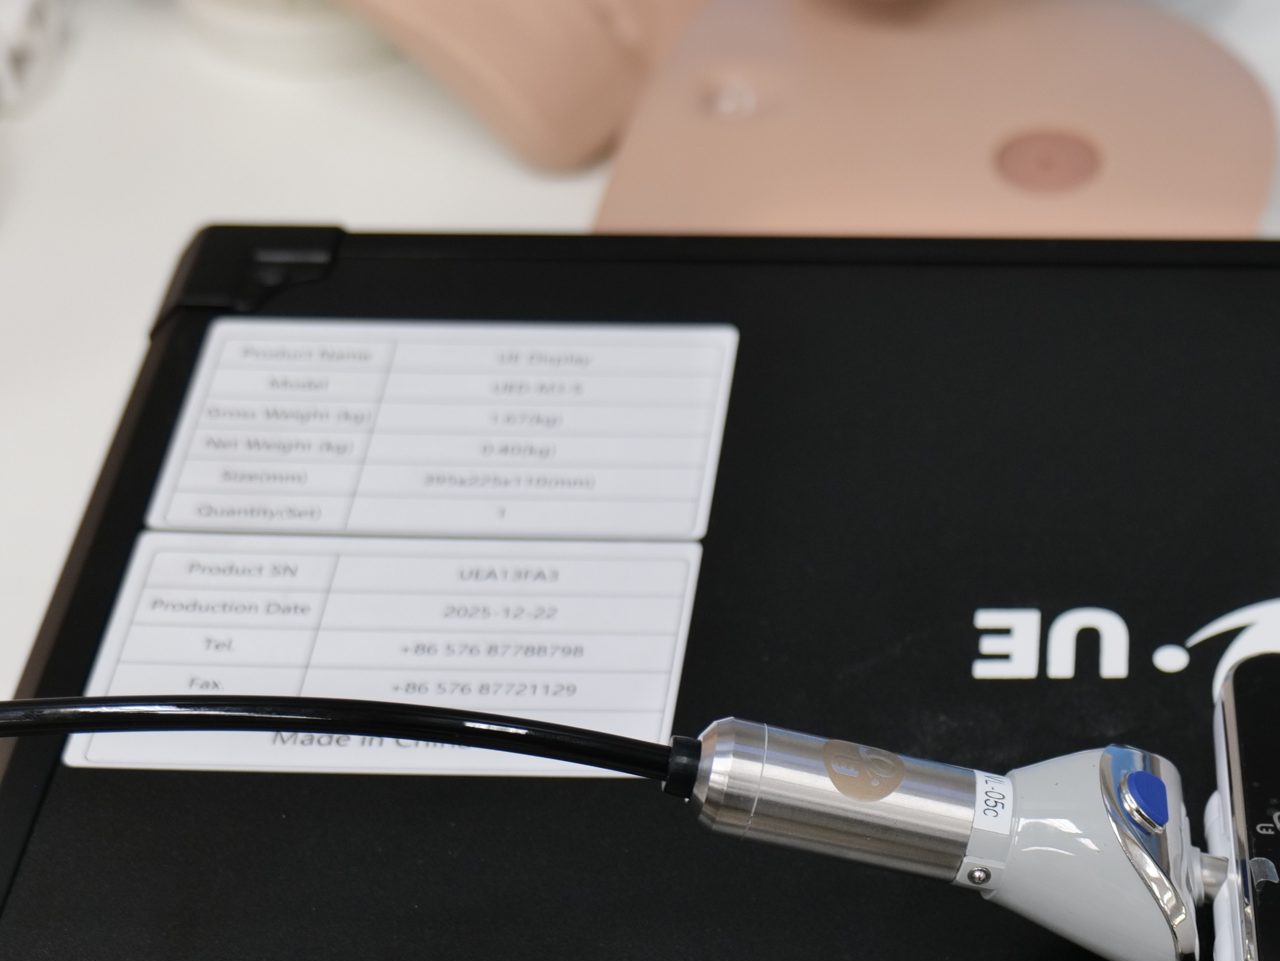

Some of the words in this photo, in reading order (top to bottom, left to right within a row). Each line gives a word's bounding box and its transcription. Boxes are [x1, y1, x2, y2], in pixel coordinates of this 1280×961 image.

[188, 561, 263, 577] Product
[271, 563, 299, 577] SN
[150, 598, 258, 617] Production
[264, 601, 312, 617] Date
[442, 604, 559, 621] 2025-12-22
[445, 643, 480, 658] 576
[486, 643, 586, 659] 87788798
[437, 680, 472, 696] 576
[478, 682, 578, 699] 87721129
[272, 730, 350, 747] Made
